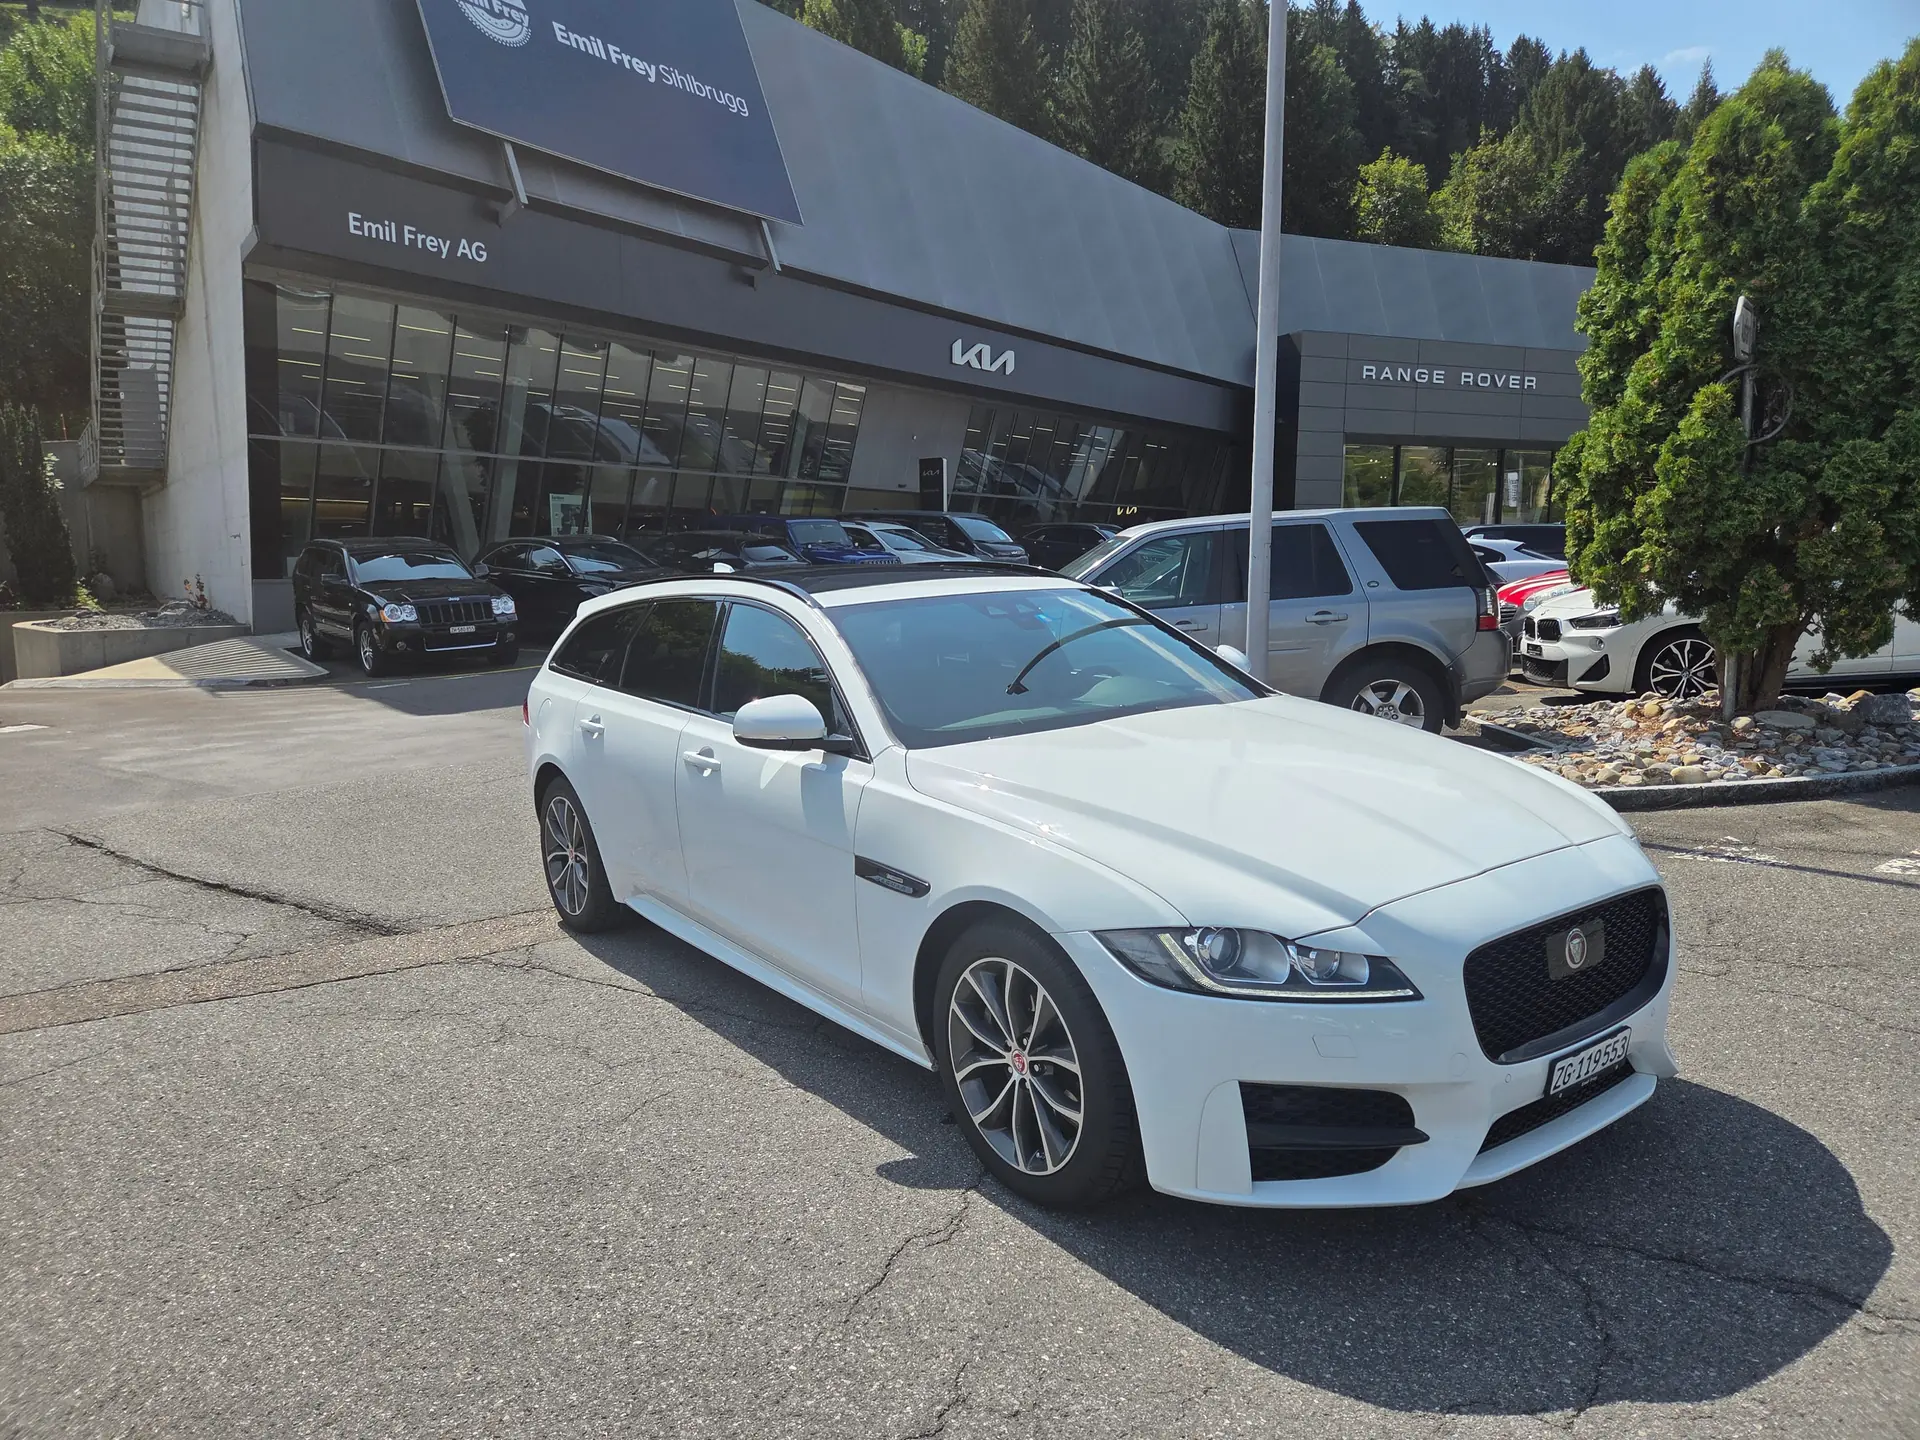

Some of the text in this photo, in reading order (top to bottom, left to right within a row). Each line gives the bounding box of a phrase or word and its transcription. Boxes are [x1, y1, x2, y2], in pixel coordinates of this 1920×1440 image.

[552, 21, 749, 117] Emil Frey Sihlbrugg
[348, 212, 487, 262] Emil Frey AG
[952, 339, 1015, 375] KIA
[1362, 365, 1537, 389] RANGE ROVER
